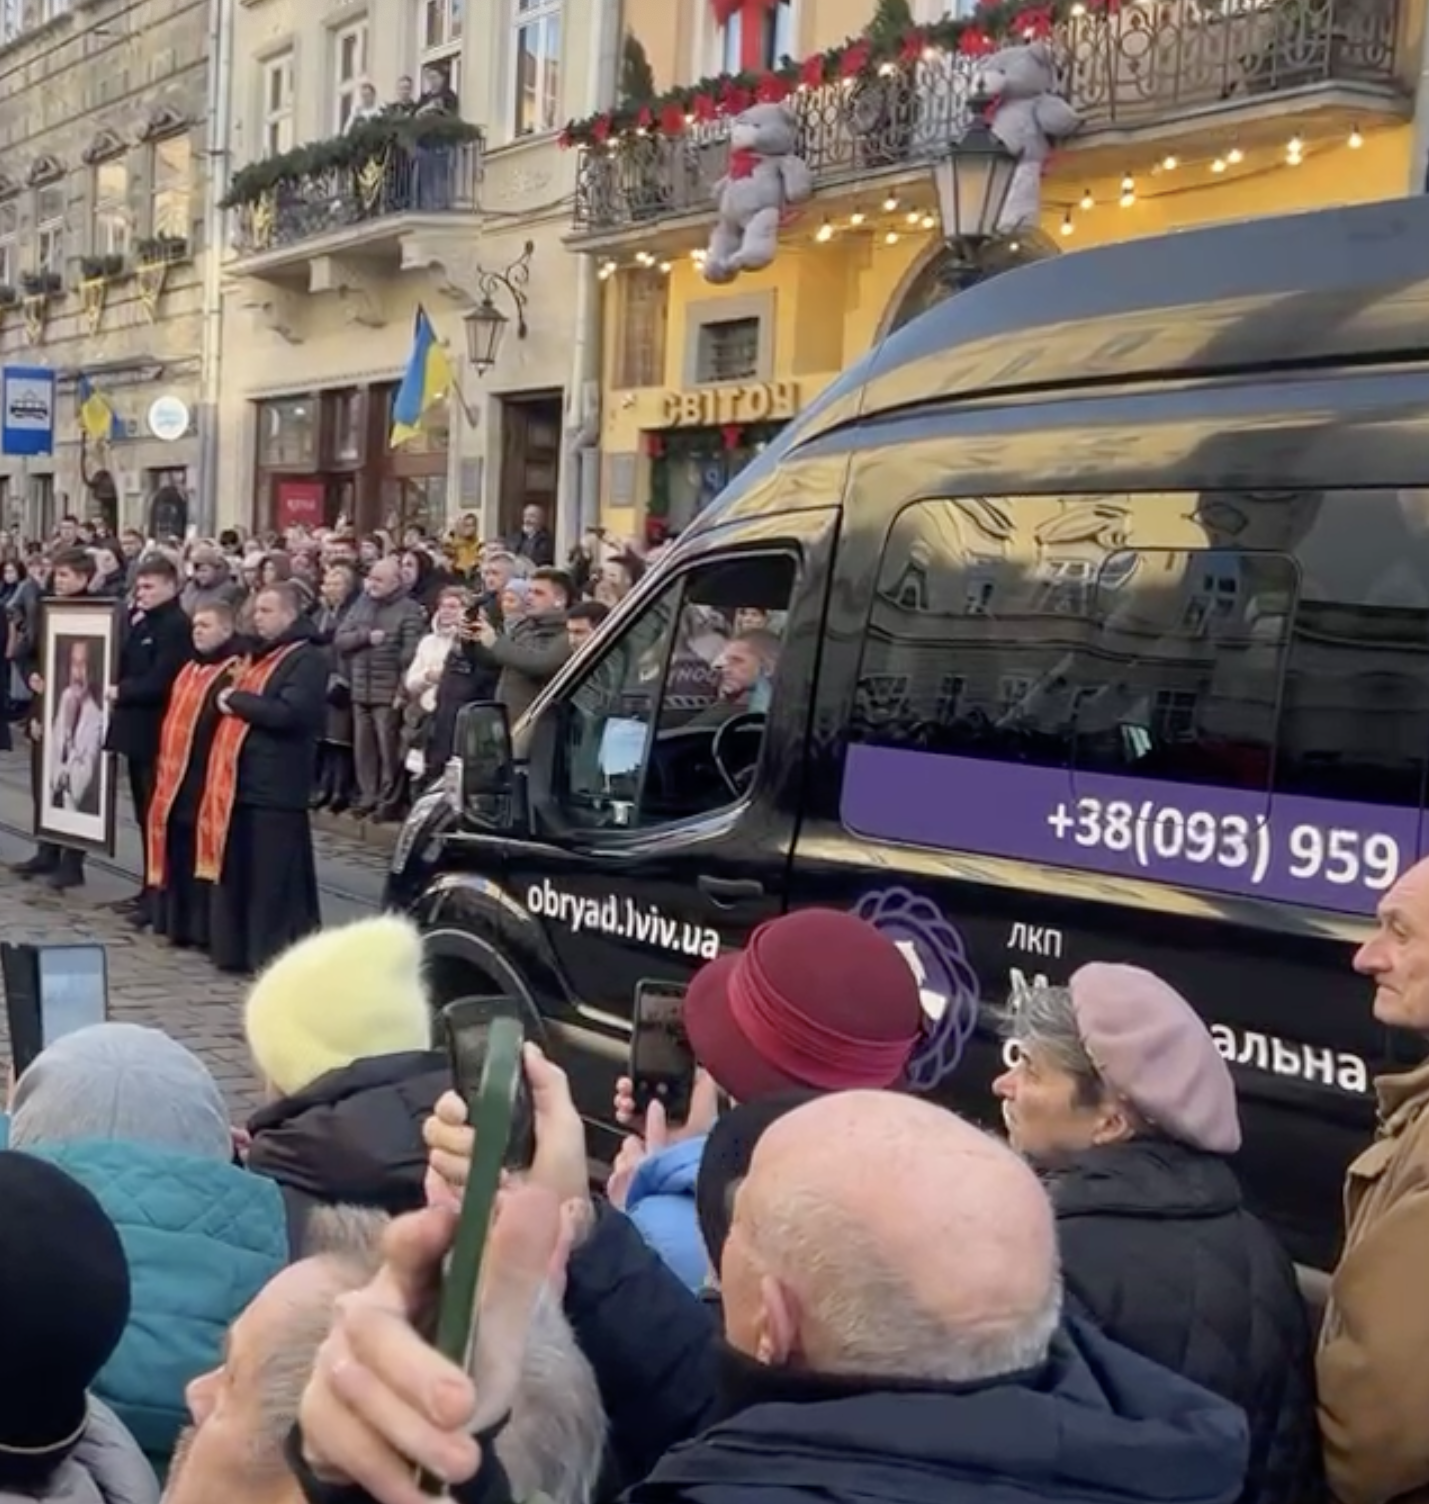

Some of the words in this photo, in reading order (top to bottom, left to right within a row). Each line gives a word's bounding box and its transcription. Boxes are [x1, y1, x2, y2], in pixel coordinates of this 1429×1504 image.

[662, 381, 800, 426] СВІТОЧ
[1047, 797, 1270, 884] +38(093)
[1288, 824, 1400, 890] 959
[527, 877, 721, 960] obryad.lviv.ua
[1006, 921, 1063, 959] ЛКП
[1209, 1022, 1368, 1093] альна
